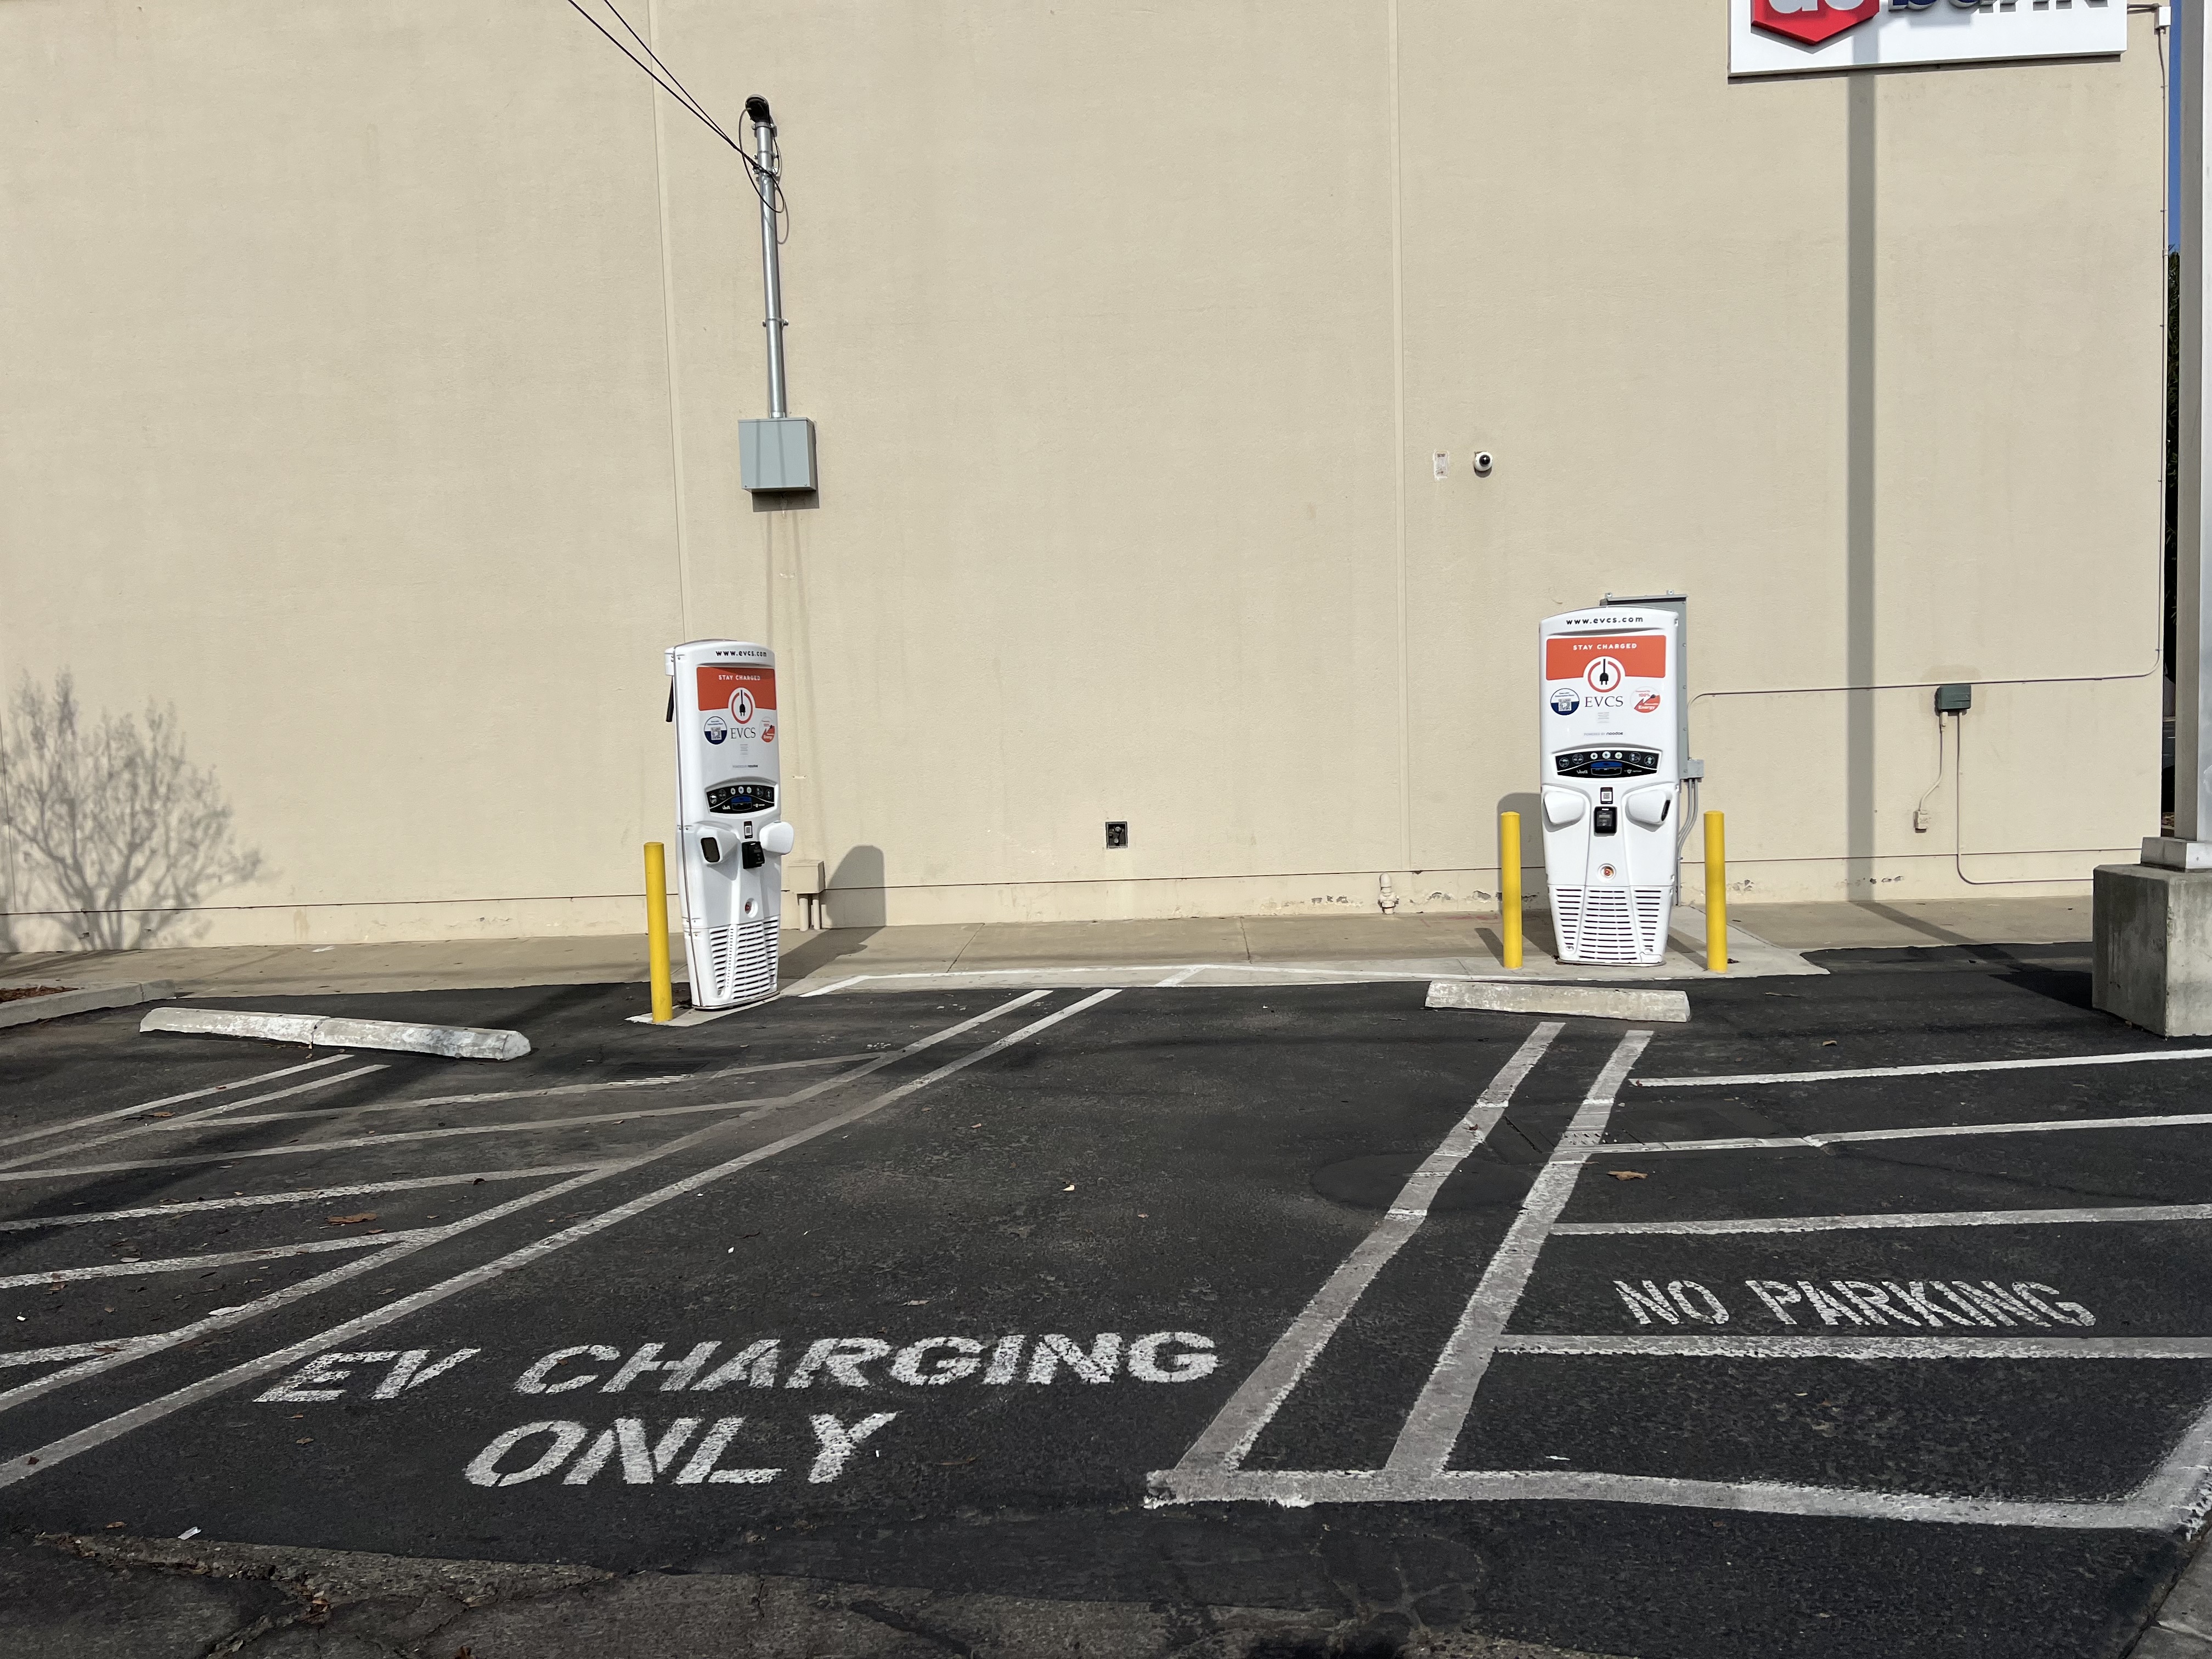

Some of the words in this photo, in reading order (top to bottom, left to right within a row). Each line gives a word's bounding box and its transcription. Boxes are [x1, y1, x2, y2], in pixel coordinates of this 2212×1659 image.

[1566, 617, 1644, 625] www.evcs.com
[1584, 696, 1624, 708] EVCS
[730, 727, 756, 739] EVCS
[1613, 1280, 1729, 1325] NO
[1745, 1280, 2096, 1327] PARKING
[252, 1348, 481, 1402] EV
[512, 1331, 1219, 1394] CHARGING
[464, 1410, 900, 1487] ONLY
